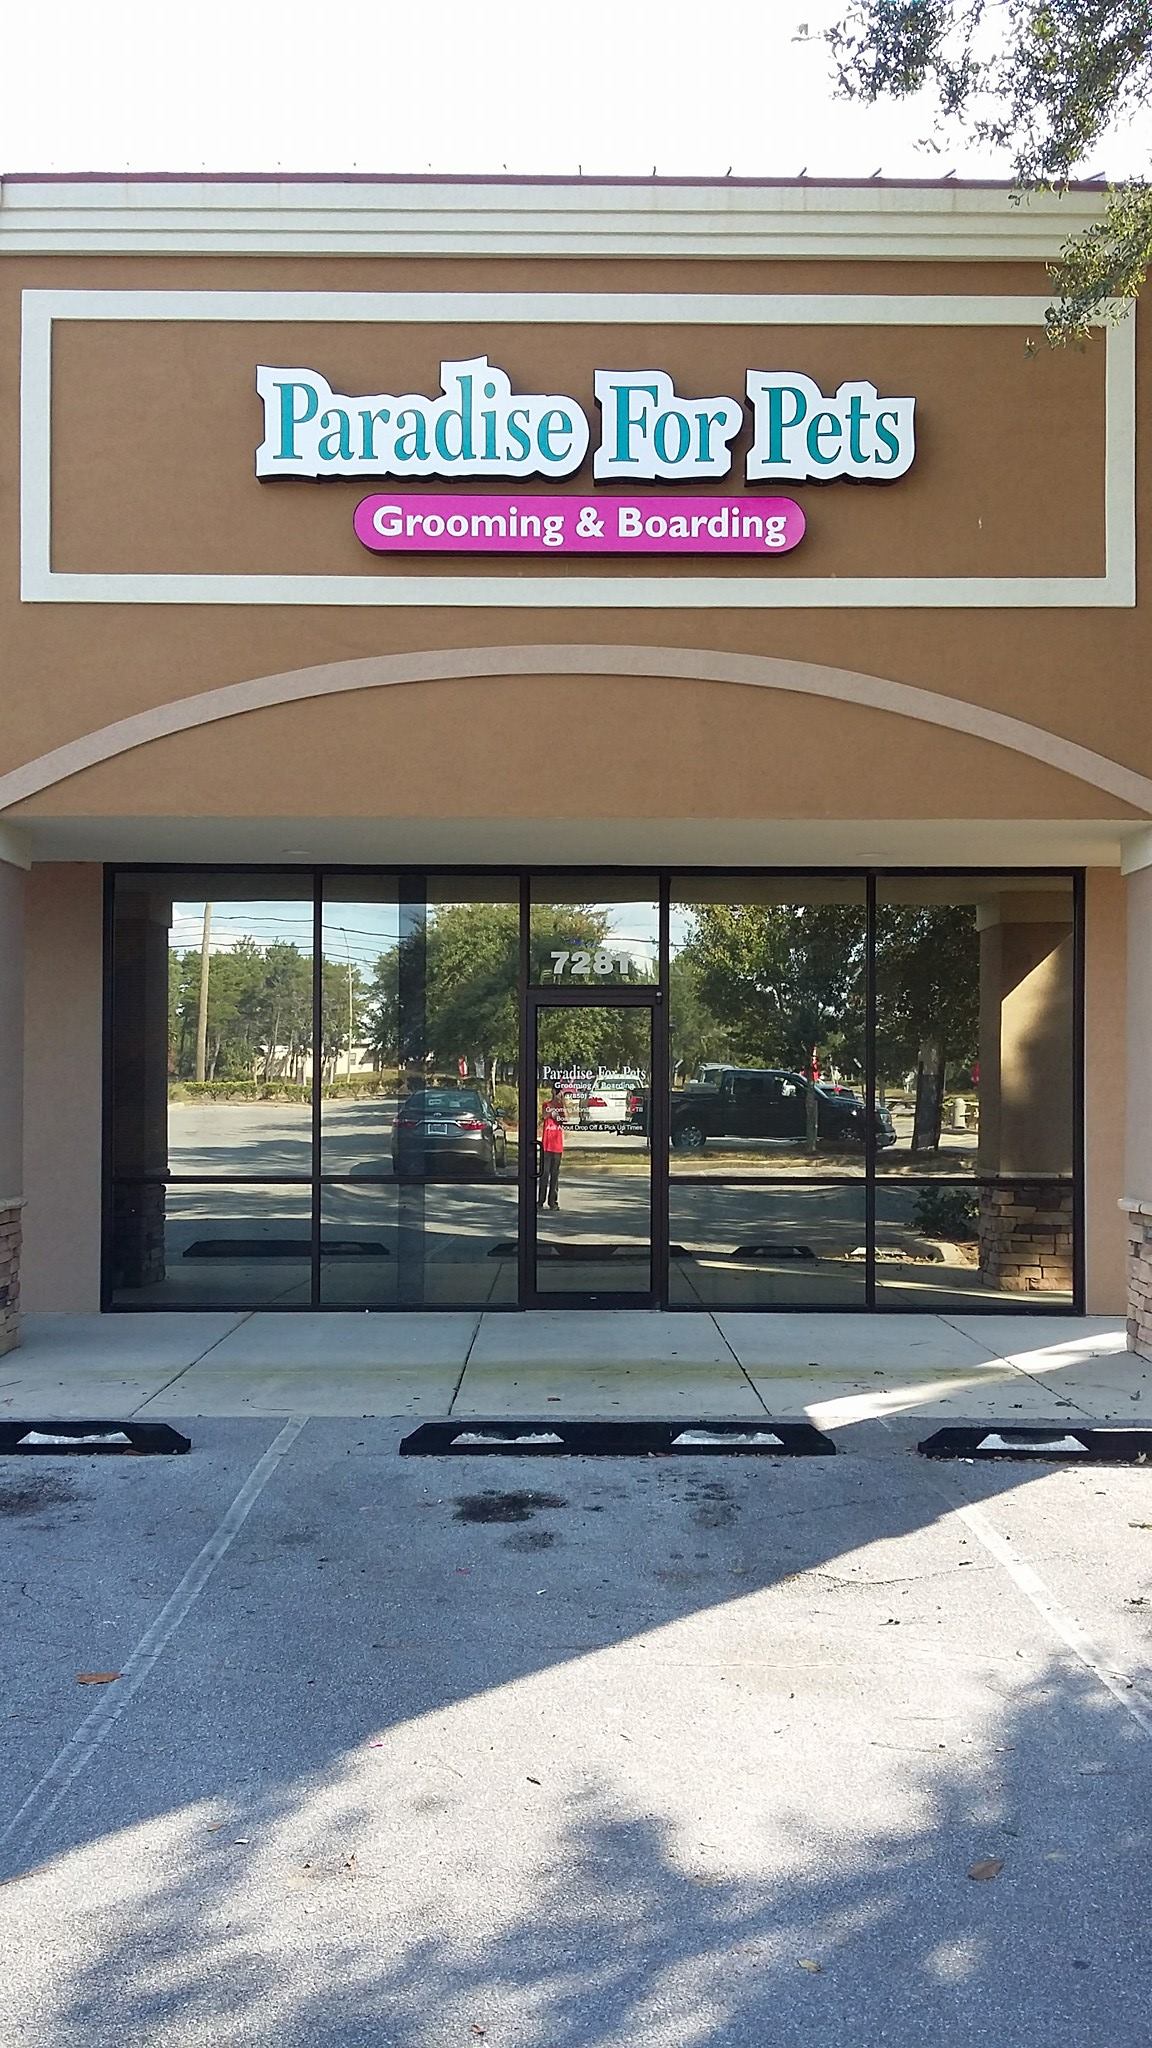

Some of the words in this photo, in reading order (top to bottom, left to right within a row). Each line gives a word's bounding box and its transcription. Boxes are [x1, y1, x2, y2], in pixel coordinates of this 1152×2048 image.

[272, 373, 573, 463] Paradise
[608, 385, 726, 464] For
[760, 386, 900, 465] Pets
[371, 506, 565, 545] Grooming
[576, 506, 604, 538] &
[617, 506, 788, 546] Boarding
[550, 950, 630, 975] 7281
[543, 1065, 593, 1080] Paradise
[598, 1065, 617, 1080] For
[622, 1065, 647, 1080] Pets
[554, 1081, 592, 1090] Grooming
[601, 1081, 635, 1090] Boarding
[574, 1124, 589, 1132] Drop
